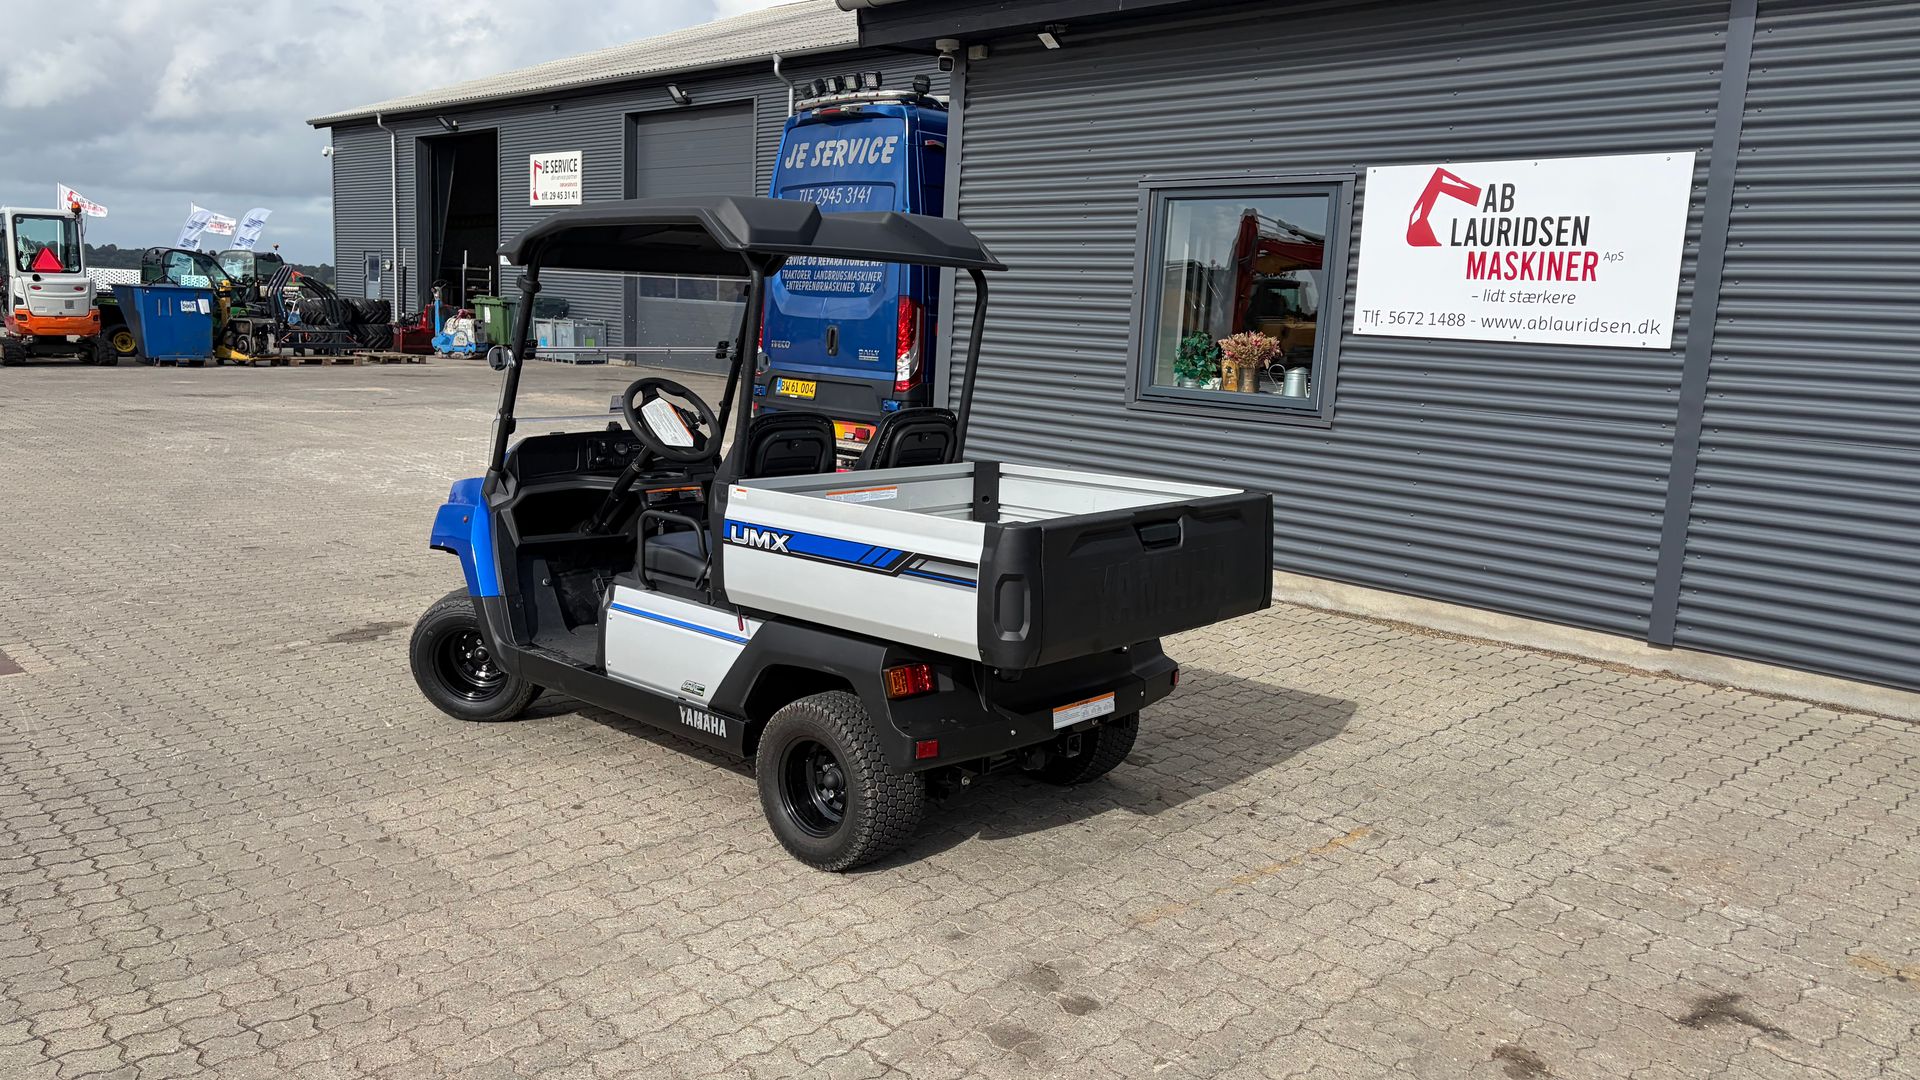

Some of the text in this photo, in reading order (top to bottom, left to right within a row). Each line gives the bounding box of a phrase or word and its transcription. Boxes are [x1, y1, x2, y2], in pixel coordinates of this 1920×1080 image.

[785, 136, 898, 169] JE SERVICE
[542, 158, 578, 174] JE SERVICE
[815, 187, 844, 206] 2945
[845, 186, 872, 204] 3141
[1482, 183, 1516, 213] AB
[1450, 215, 1590, 247] LAURIDSEN
[785, 255, 807, 266] ERVICE
[1465, 251, 1625, 282] MASKINER ApS
[781, 269, 883, 282] TRAKTORER LANDBRUGSMASKINER
[859, 282, 876, 293] DÆK
[1482, 288, 1506, 303] lidt
[1508, 291, 1577, 305] stærkere
[1362, 309, 1384, 327] Tlf.
[1388, 310, 1424, 326] 5672
[1428, 312, 1466, 327] 1488
[1481, 316, 1661, 336] www.ablauridsen.dk
[771, 340, 791, 349] IVECO
[858, 348, 880, 356] DAILY
[731, 525, 790, 553] UMX
[679, 705, 727, 738] YAMAHA
